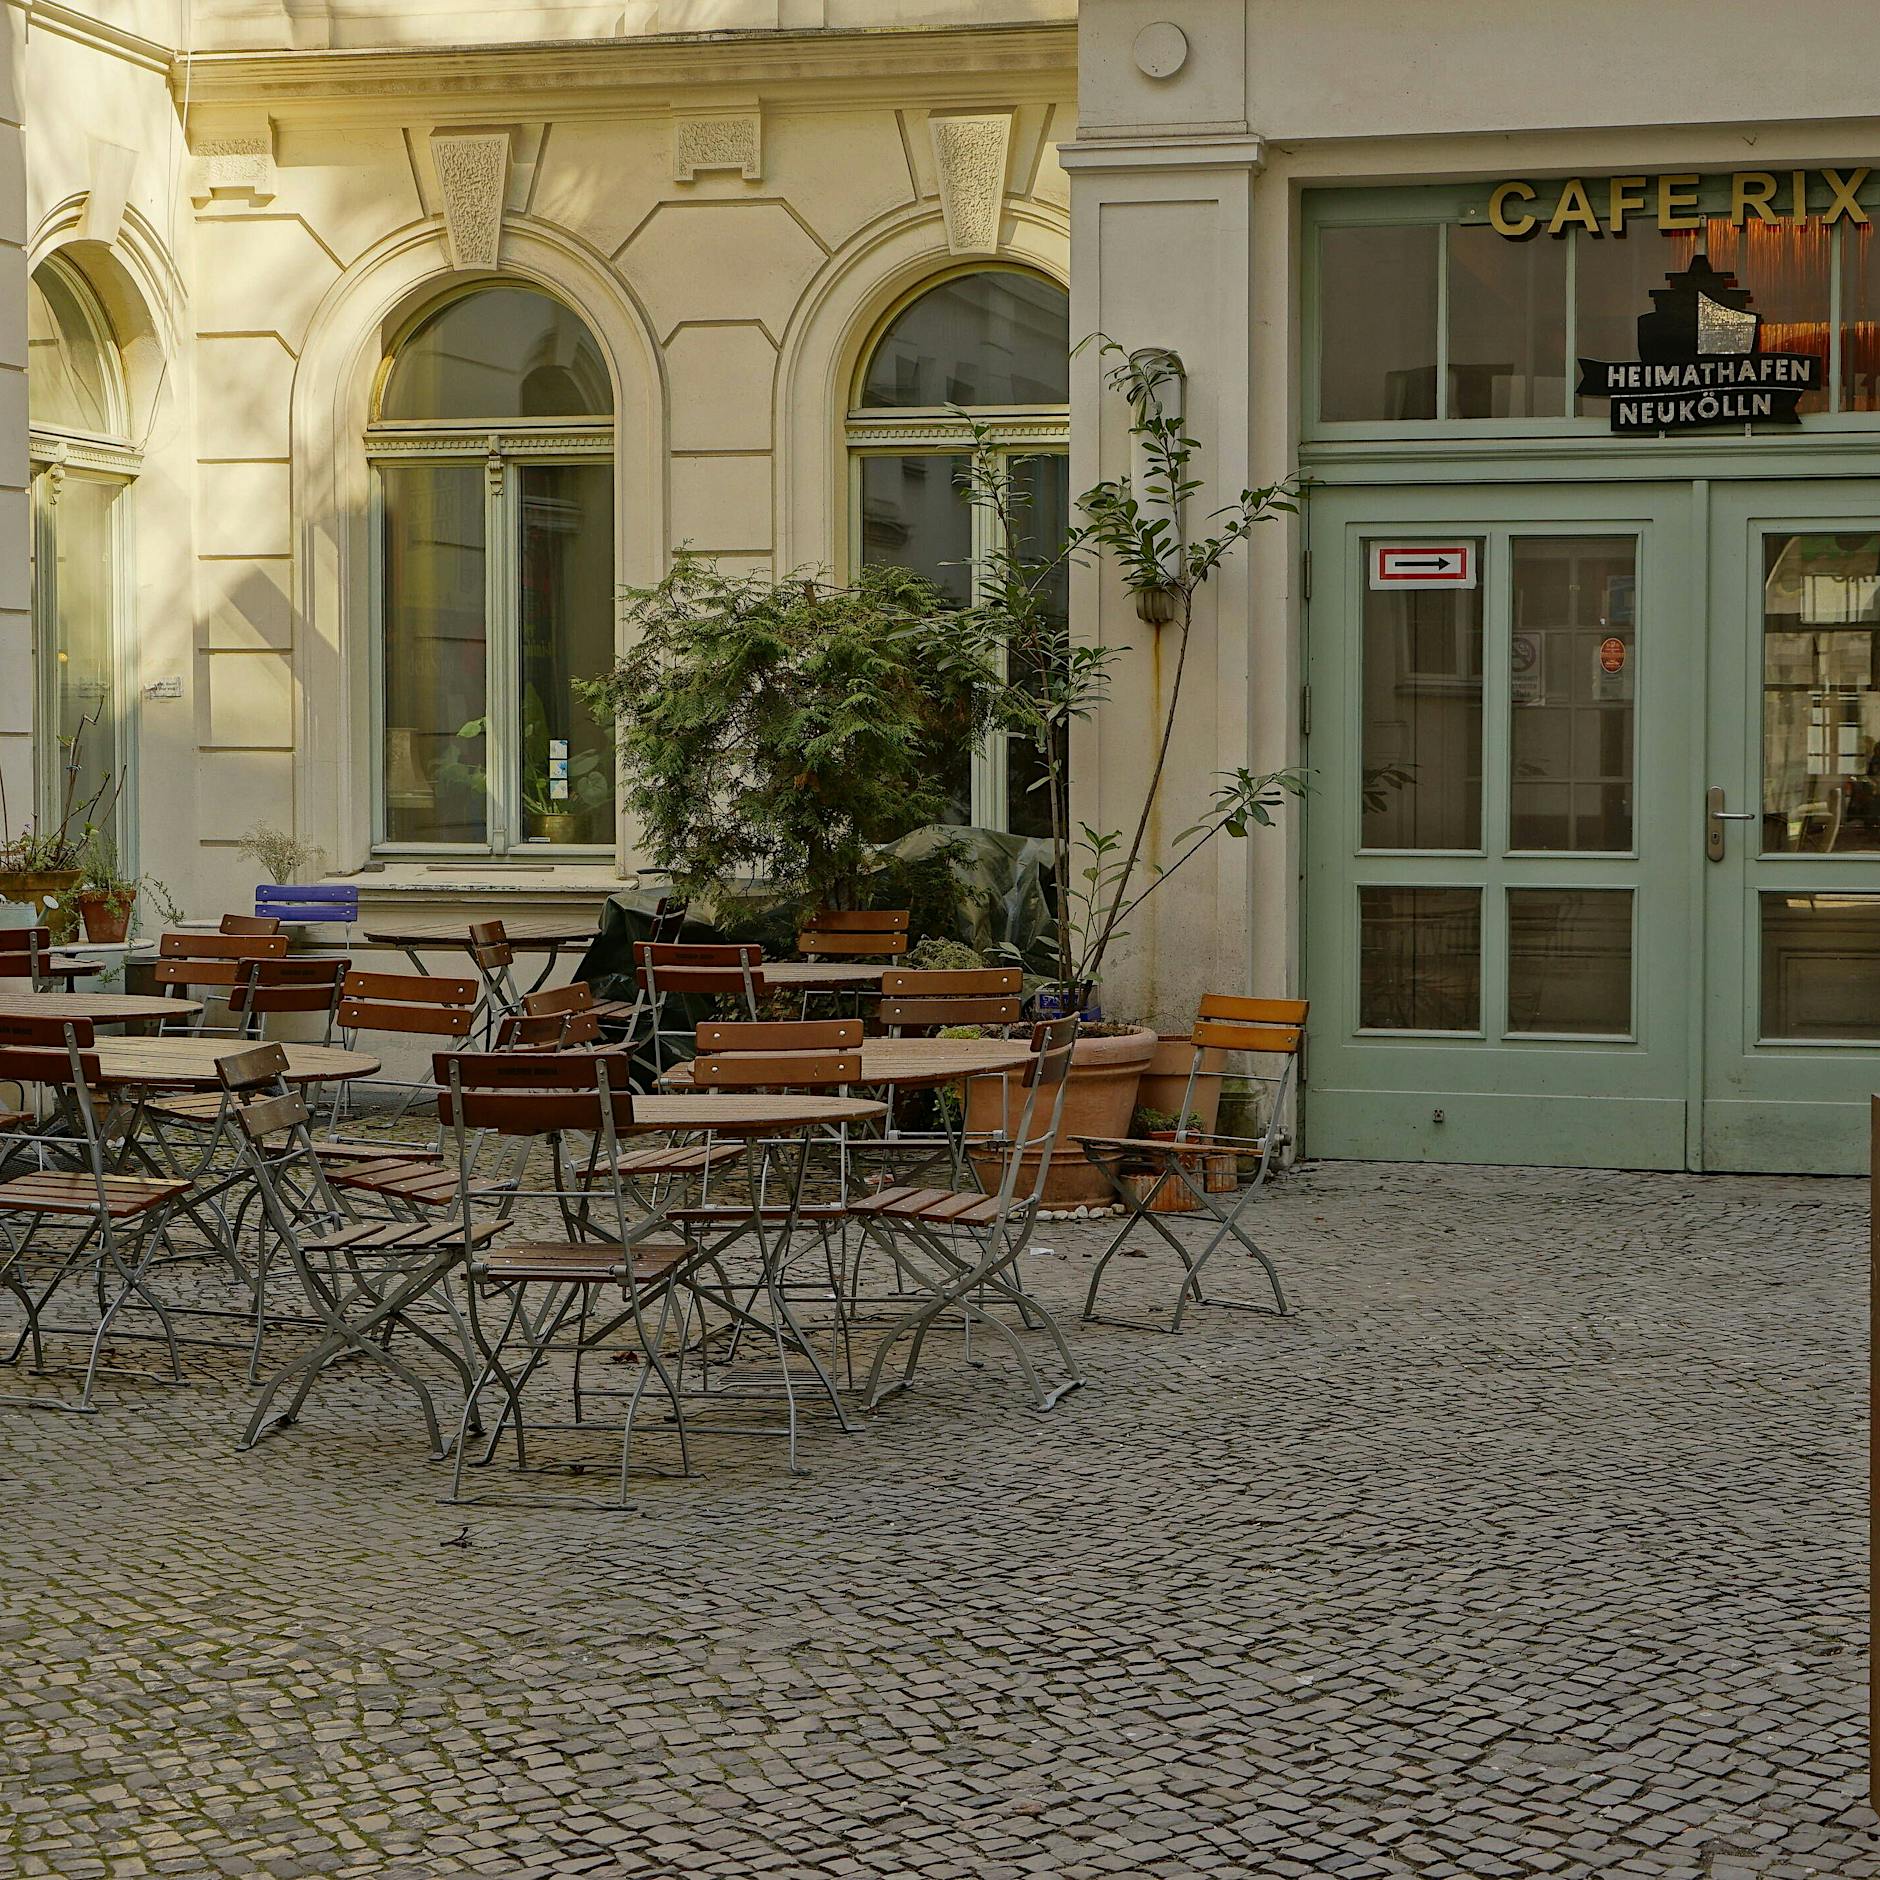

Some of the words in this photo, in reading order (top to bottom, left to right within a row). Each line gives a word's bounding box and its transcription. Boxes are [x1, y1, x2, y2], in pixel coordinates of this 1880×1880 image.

[1488, 174, 1701, 236] CAFE
[1731, 167, 1871, 226] RIX
[1607, 359, 1811, 388] HEIMATHAFEN
[1619, 391, 1771, 425] NEUKÖLLN
